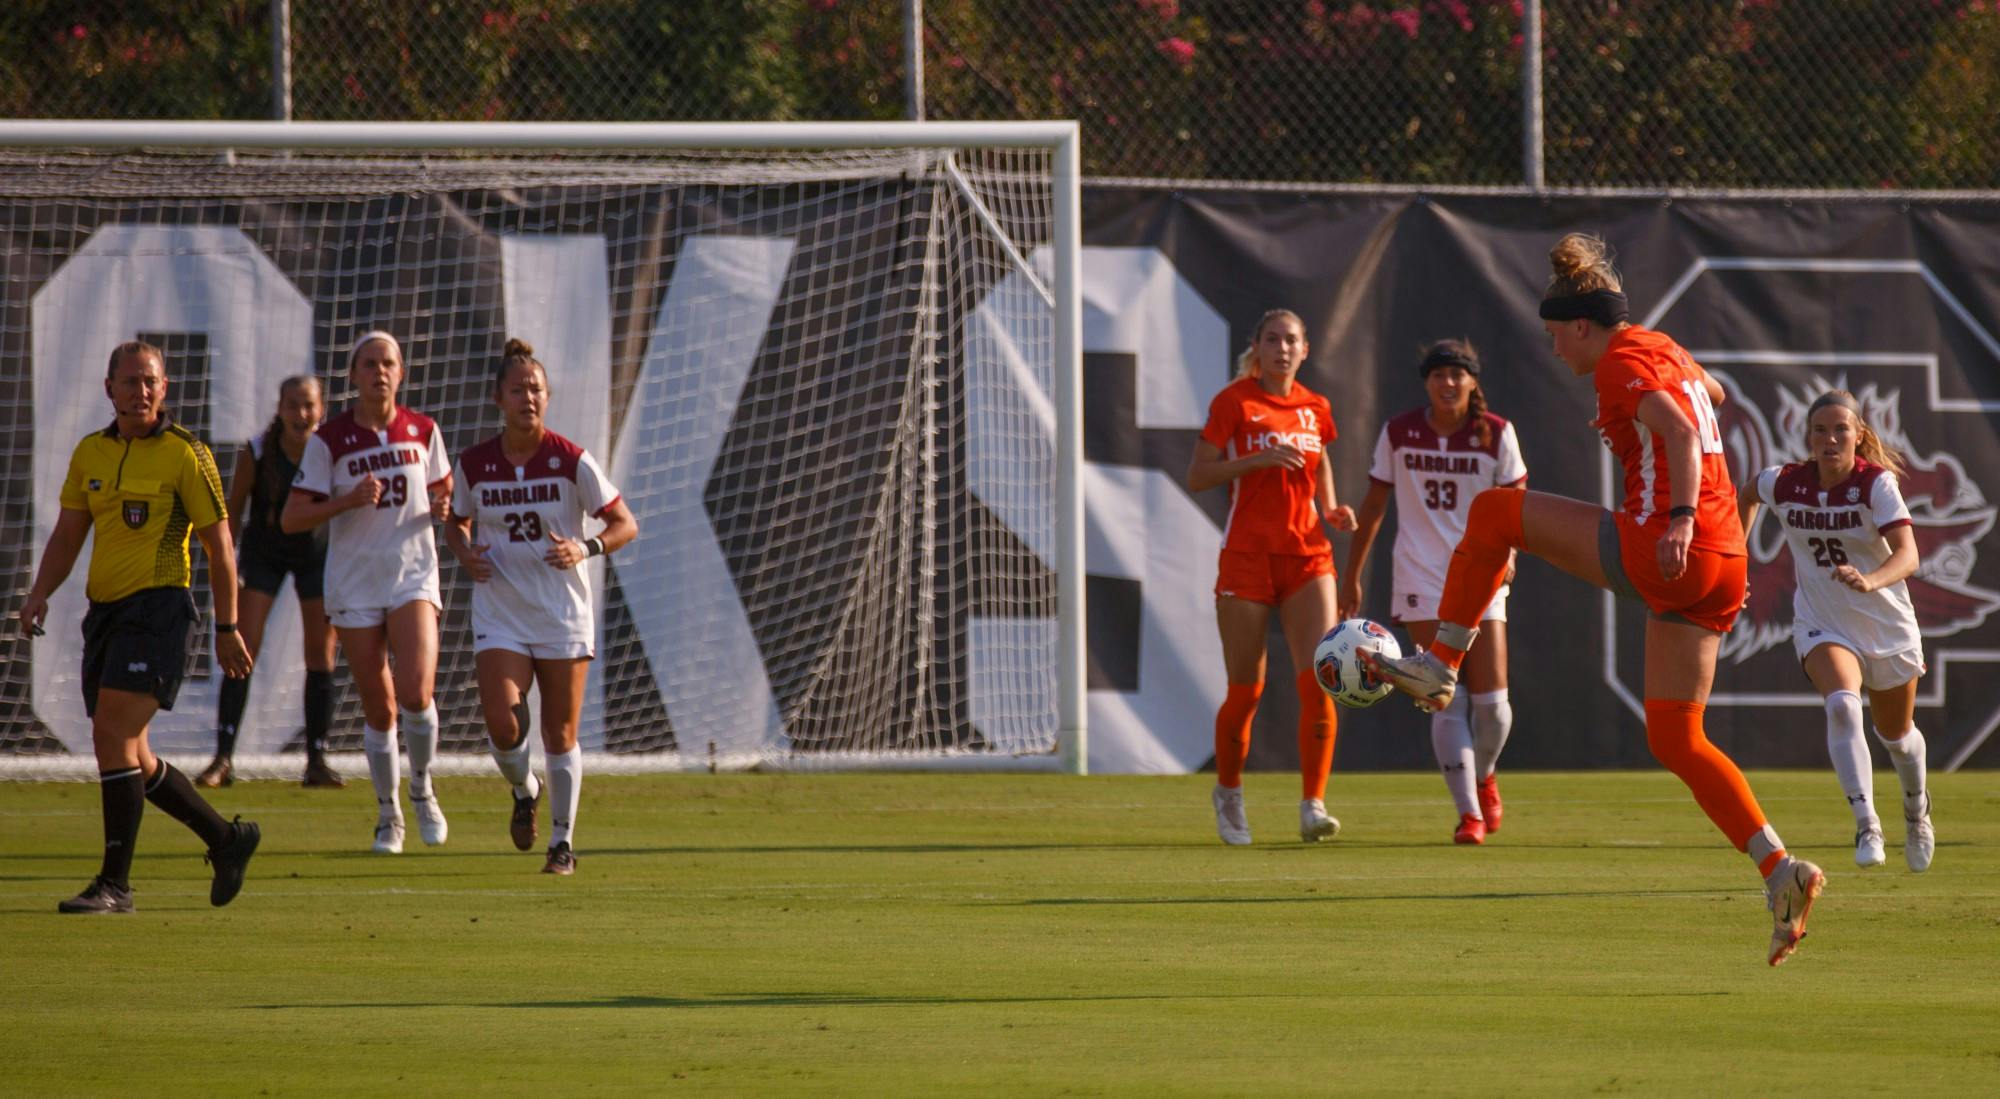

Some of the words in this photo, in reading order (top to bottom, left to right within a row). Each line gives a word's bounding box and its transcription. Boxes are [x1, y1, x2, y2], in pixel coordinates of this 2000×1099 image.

[1297, 408, 1317, 431] 12
[1681, 379, 1724, 454] 18
[1247, 431, 1322, 453] HOKIES
[347, 448, 420, 477] CAROLINA
[1404, 453, 1480, 475] CAROLINA
[376, 474, 409, 511] 29
[482, 483, 561, 508] CAROLINA
[1424, 479, 1458, 511] 33
[504, 511, 543, 543] 23
[1786, 509, 1863, 531] CAROLINA
[1808, 536, 1849, 567] 26
